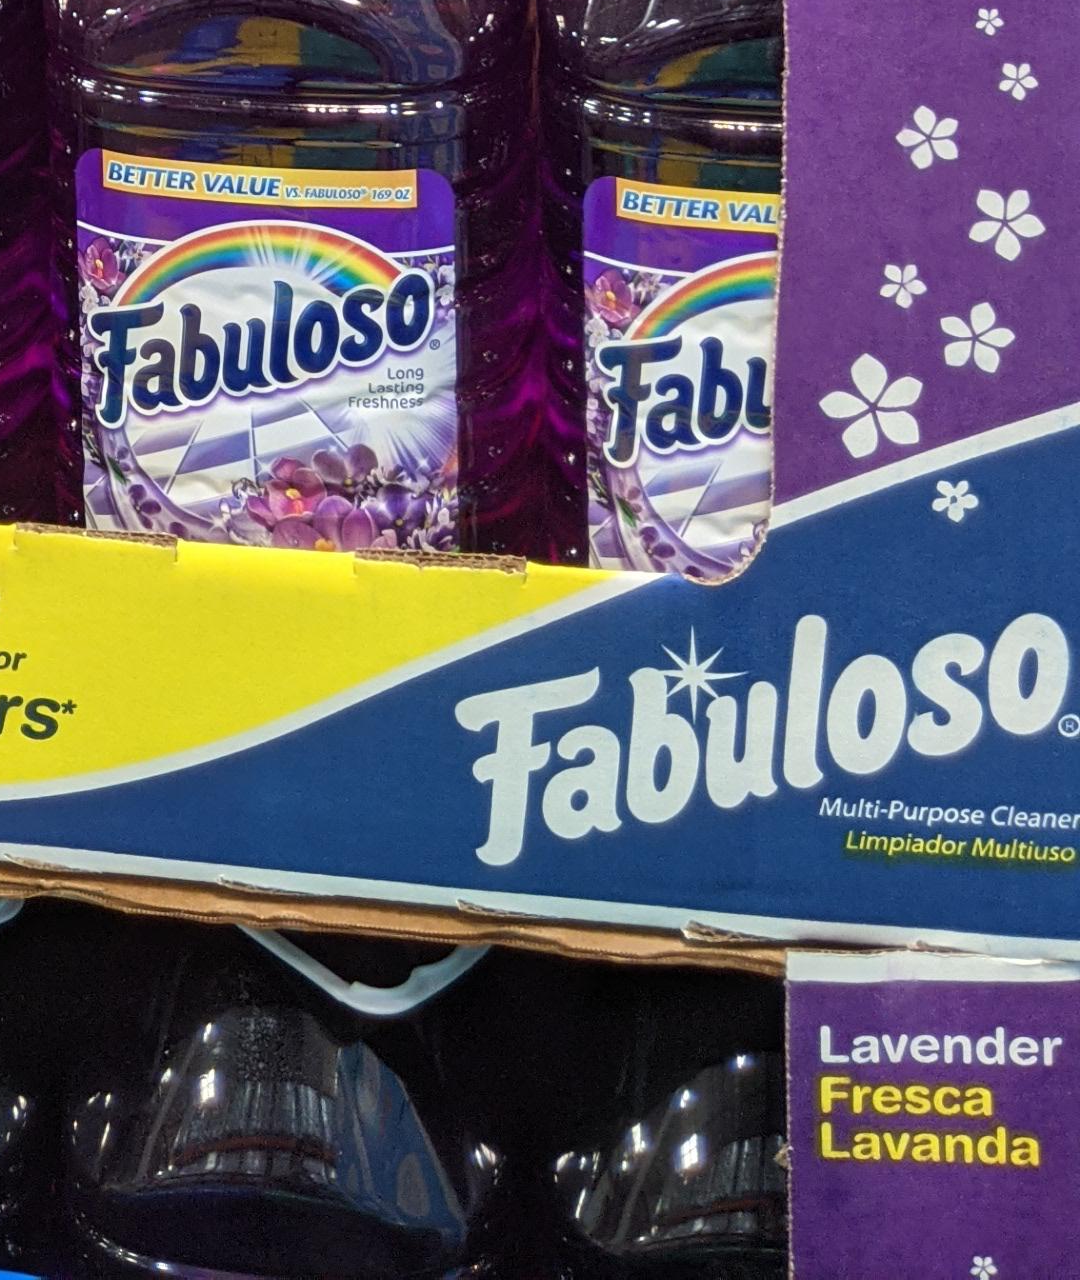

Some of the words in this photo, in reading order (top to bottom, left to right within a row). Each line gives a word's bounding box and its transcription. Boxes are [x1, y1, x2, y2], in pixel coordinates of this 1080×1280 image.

[108, 161, 196, 191] BETTER
[203, 172, 281, 198] VALUE
[285, 187, 302, 200] VS.
[372, 189, 391, 201] 169
[394, 188, 410, 201] OZ
[622, 192, 719, 222] BETTER
[728, 201, 777, 225] VAL
[91, 272, 432, 425] Fabuloso
[369, 382, 424, 396] Lasting
[387, 368, 425, 382] Long
[349, 395, 424, 409] Freshness
[454, 612, 1070, 866] Fabuloso
[819, 796, 985, 827] Multi-Purpose
[990, 806, 1080, 829] Cleaner
[846, 830, 966, 858] Limpiador
[972, 837, 1076, 863] Multiuso
[820, 1025, 1063, 1067] Lavender
[820, 1076, 993, 1116] Fresca
[821, 1122, 1040, 1167] Lavanda
